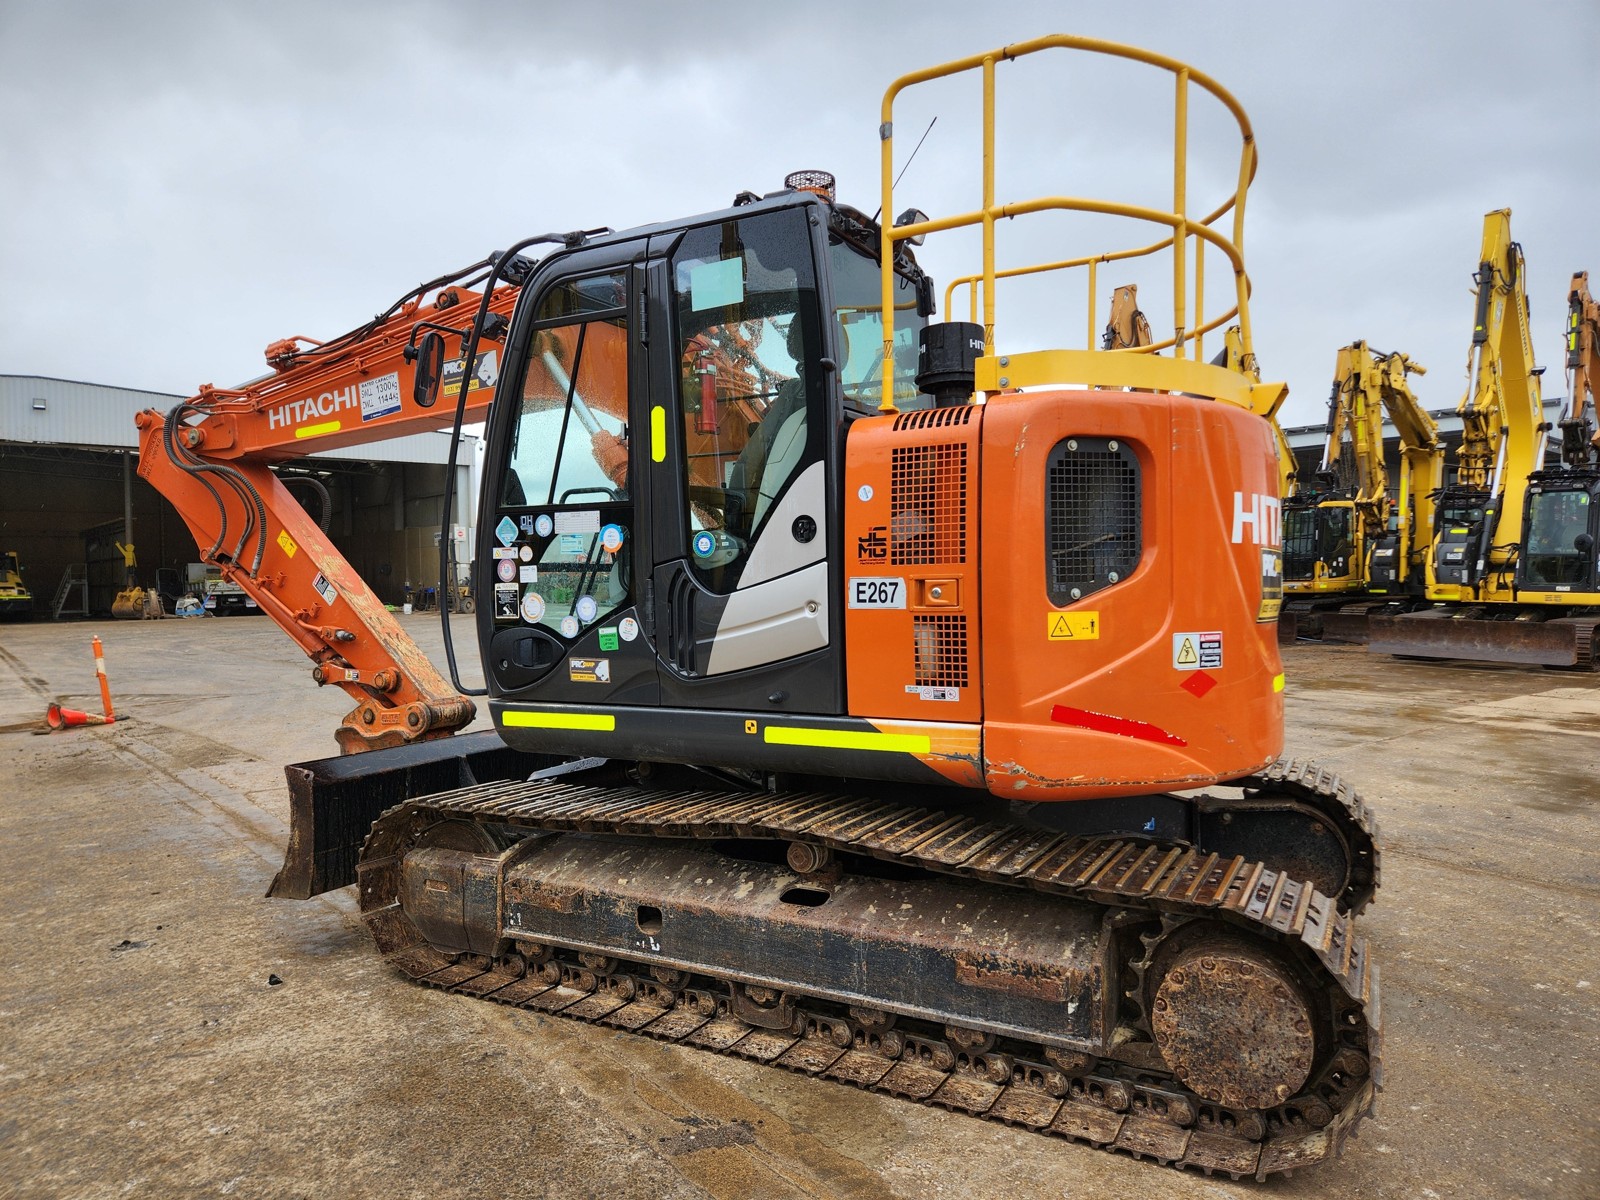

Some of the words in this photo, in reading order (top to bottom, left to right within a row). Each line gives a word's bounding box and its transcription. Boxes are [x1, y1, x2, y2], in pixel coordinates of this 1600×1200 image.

[969, 338, 985, 351] HIT
[268, 386, 357, 430] HITACHI
[856, 581, 898, 603] E267
